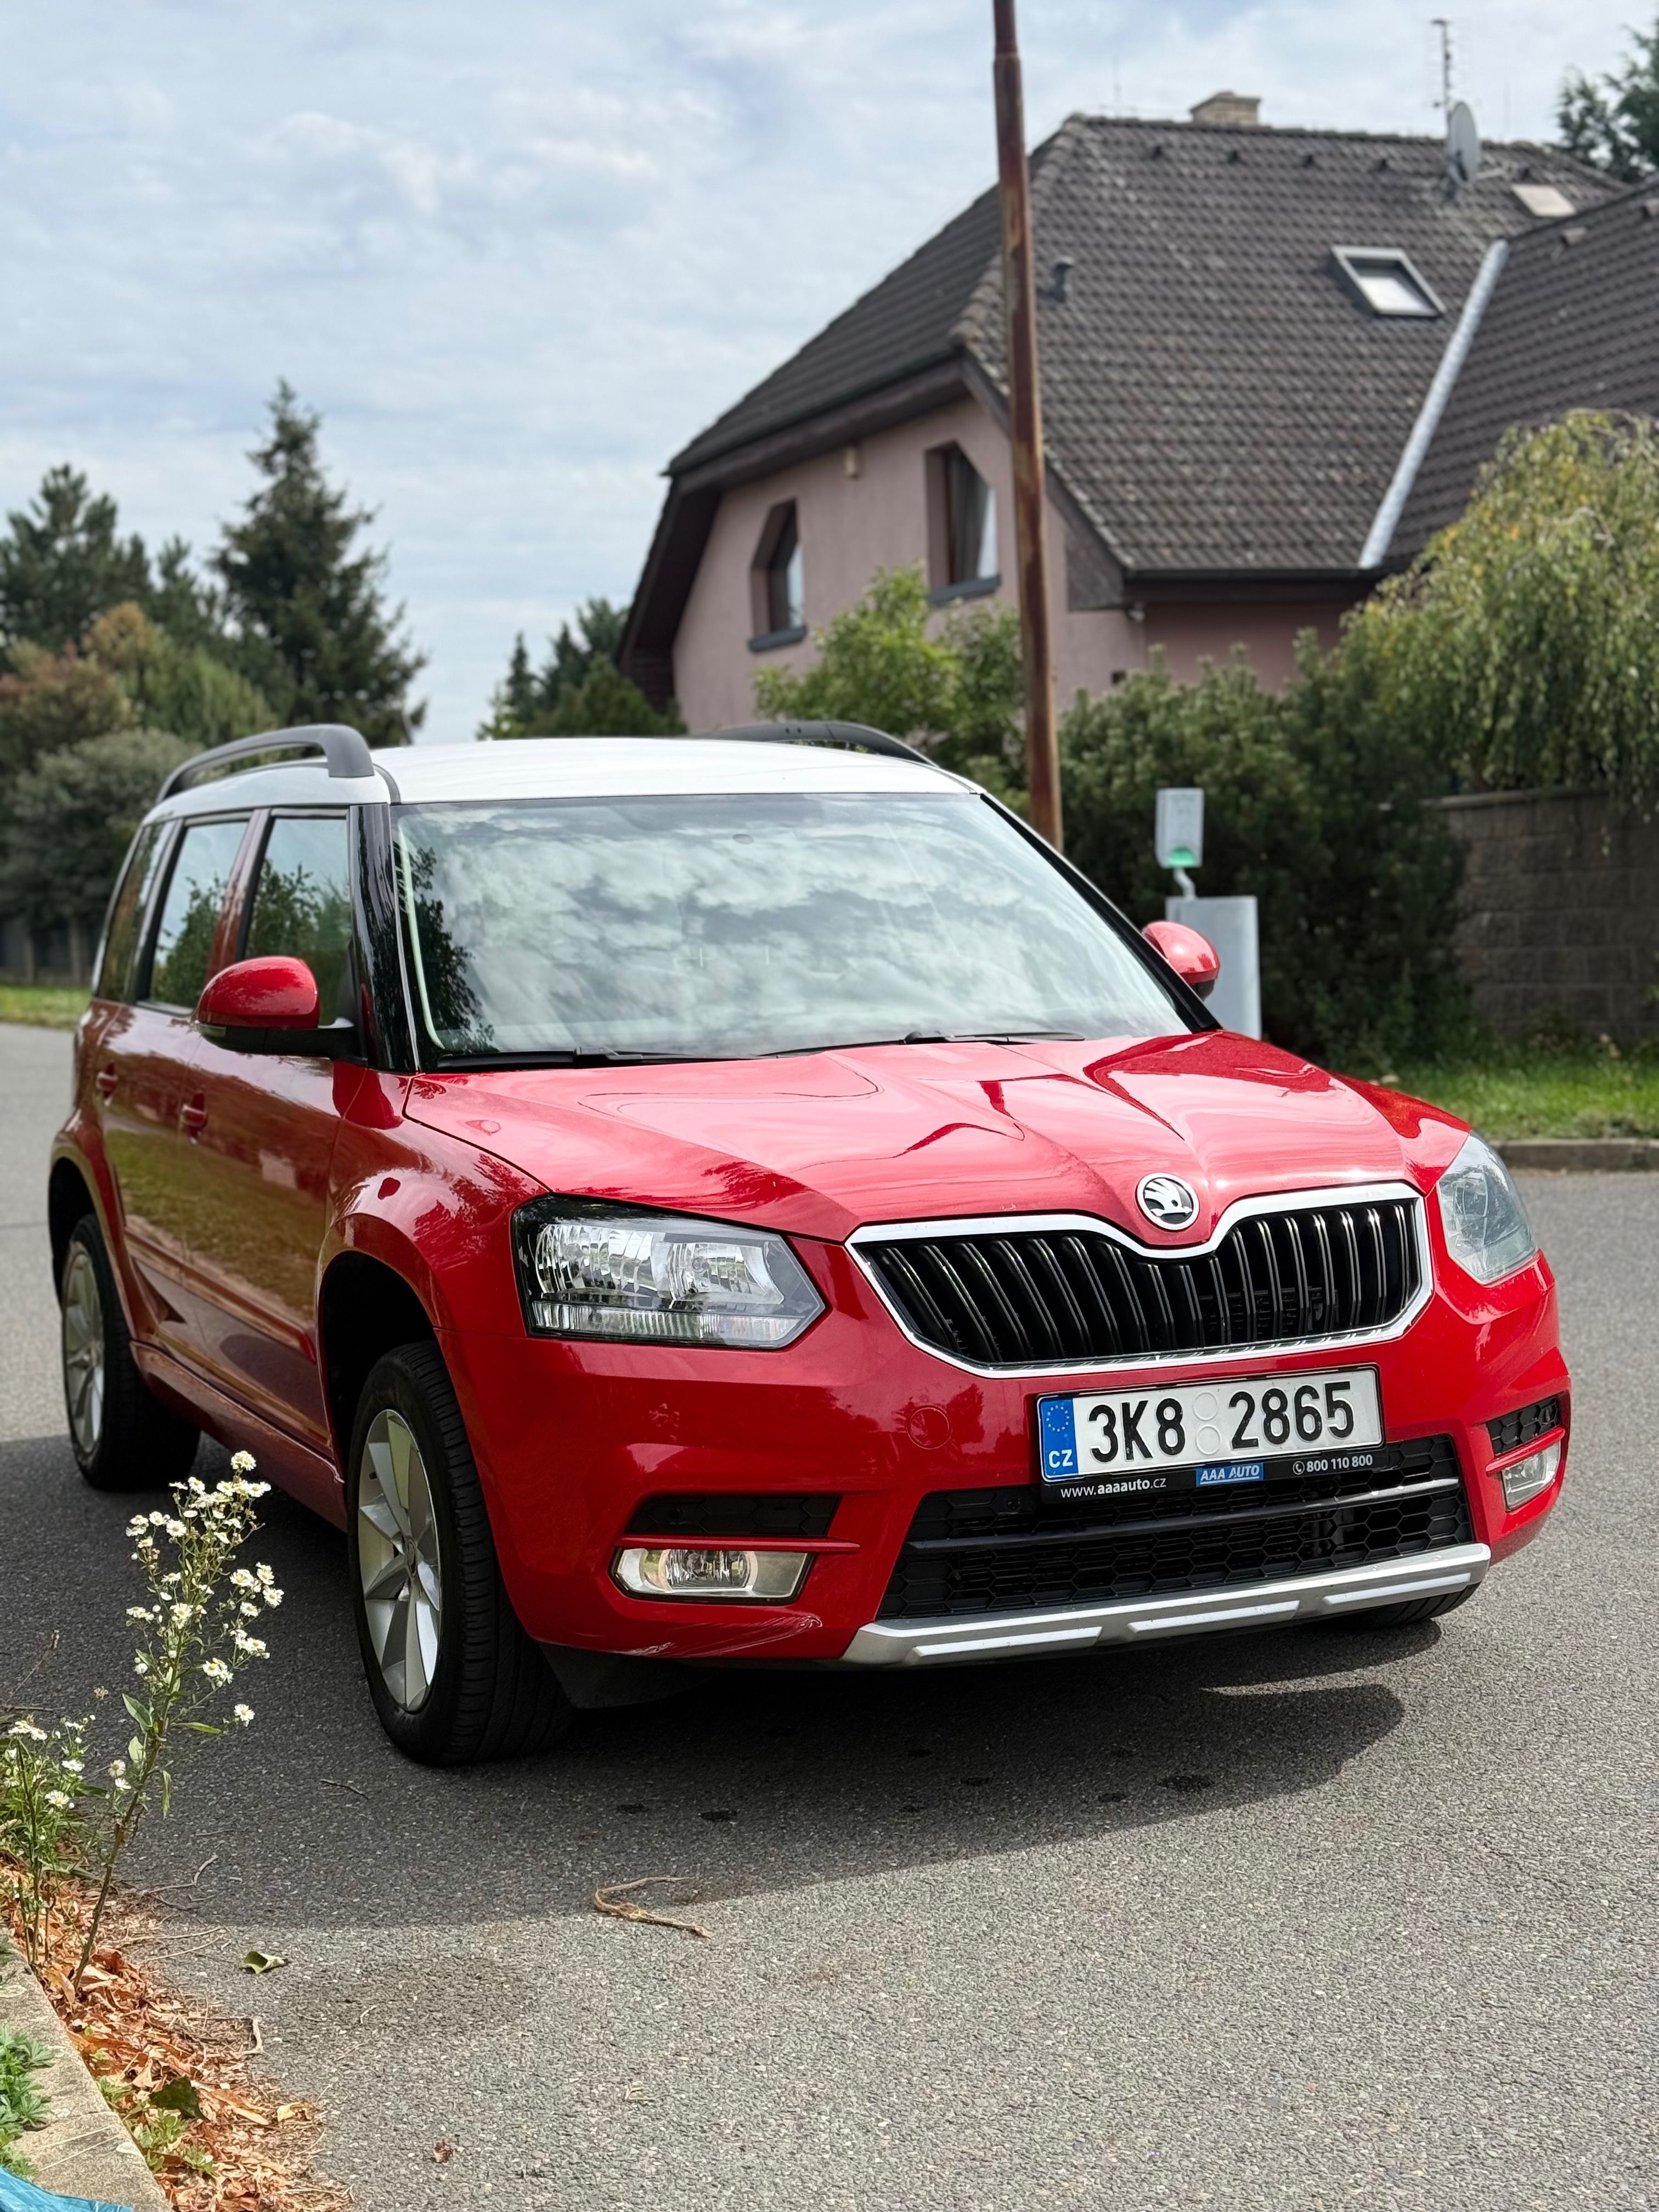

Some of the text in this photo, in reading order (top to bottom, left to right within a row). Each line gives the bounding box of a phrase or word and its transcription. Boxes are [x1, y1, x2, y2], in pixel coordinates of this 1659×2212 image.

[1088, 1381, 1354, 1463] 3K8 2865
[1048, 1449, 1074, 1469] CZ
[1306, 1454, 1373, 1472] 800 110 800
[1200, 1465, 1260, 1481] AAA AUTO
[1060, 1478, 1166, 1498] www.aaaauto.cz
